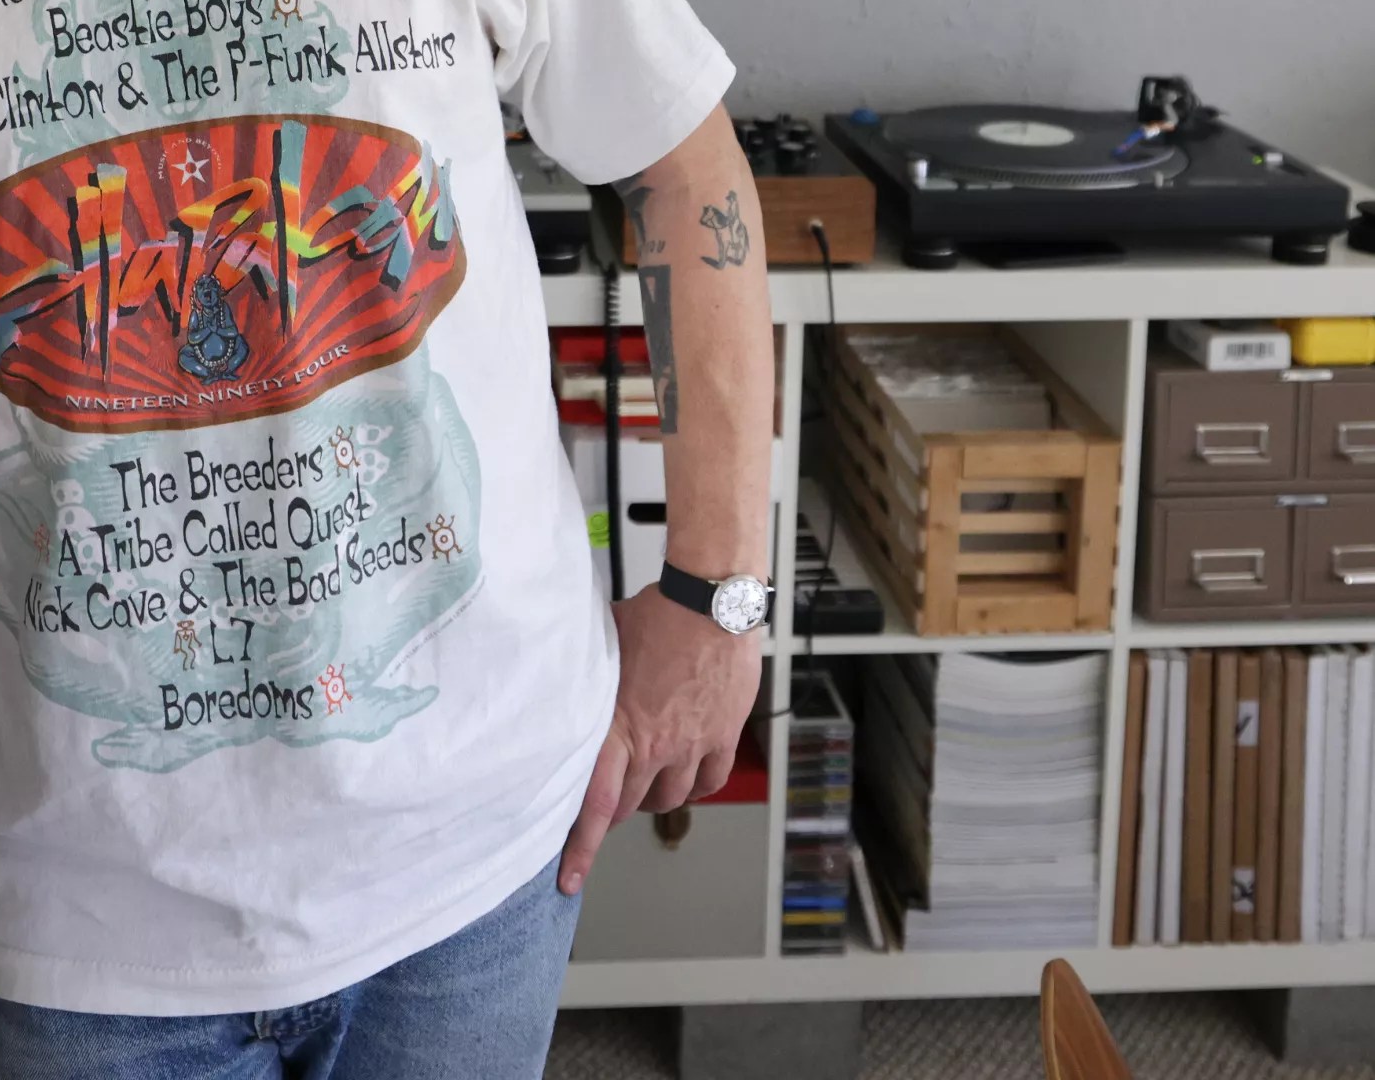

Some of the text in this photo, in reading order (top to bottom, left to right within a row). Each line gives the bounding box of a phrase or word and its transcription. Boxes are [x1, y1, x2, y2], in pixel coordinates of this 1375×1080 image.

[117, 63, 149, 111] &
[152, 52, 220, 105] The
[224, 25, 347, 102] P-Funk
[354, 18, 457, 75] Allstars
[171, 137, 193, 149] AND
[65, 342, 352, 414] NINETEEN NINETY FOUR
[110, 436, 324, 513] The Breeders
[57, 473, 371, 577] A Tribe Called Quest
[87, 584, 168, 631] Cave
[179, 569, 207, 613] &
[212, 559, 277, 609] The
[284, 545, 342, 606] Bad
[345, 518, 424, 585] Seeds
[210, 618, 255, 664] L7
[159, 669, 314, 731] Boredoms
